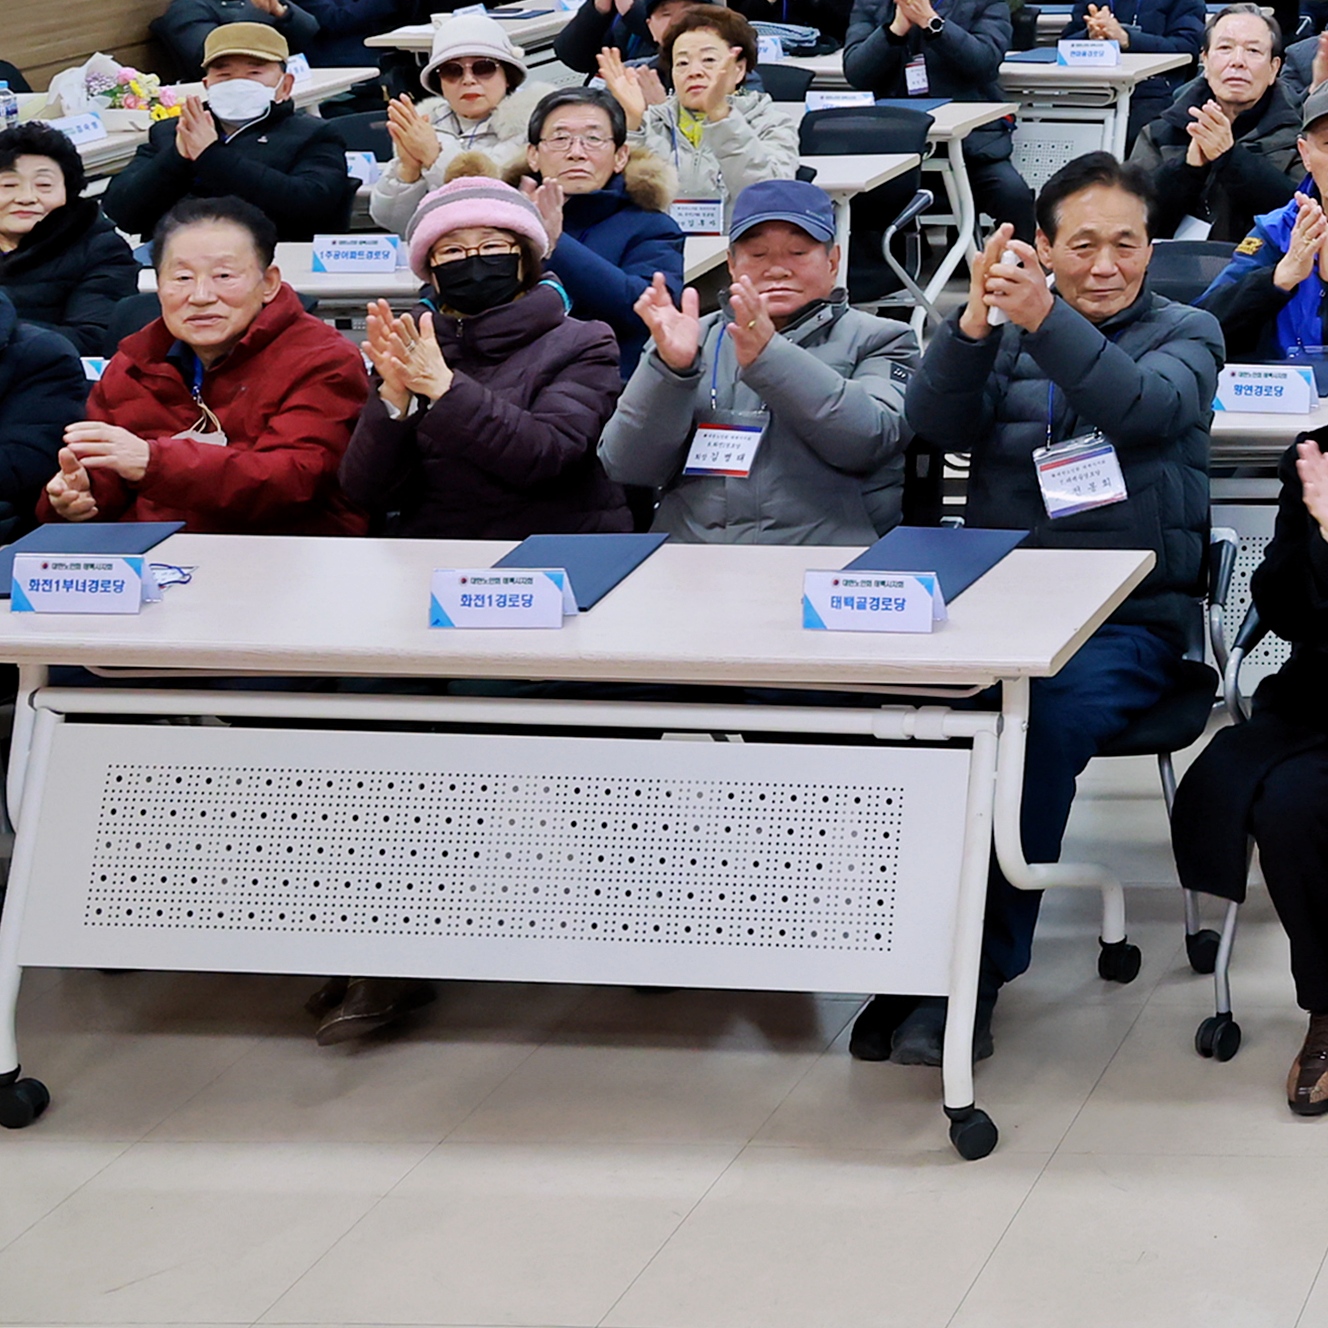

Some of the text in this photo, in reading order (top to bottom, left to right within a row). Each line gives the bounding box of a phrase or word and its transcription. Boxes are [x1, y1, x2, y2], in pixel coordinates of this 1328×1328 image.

[1234, 384, 1284, 397] 황연경로당
[28, 578, 126, 594] 화전1부녀경로당
[460, 594, 534, 608] 화전1경로당
[830, 595, 907, 612] 태백골경로당
